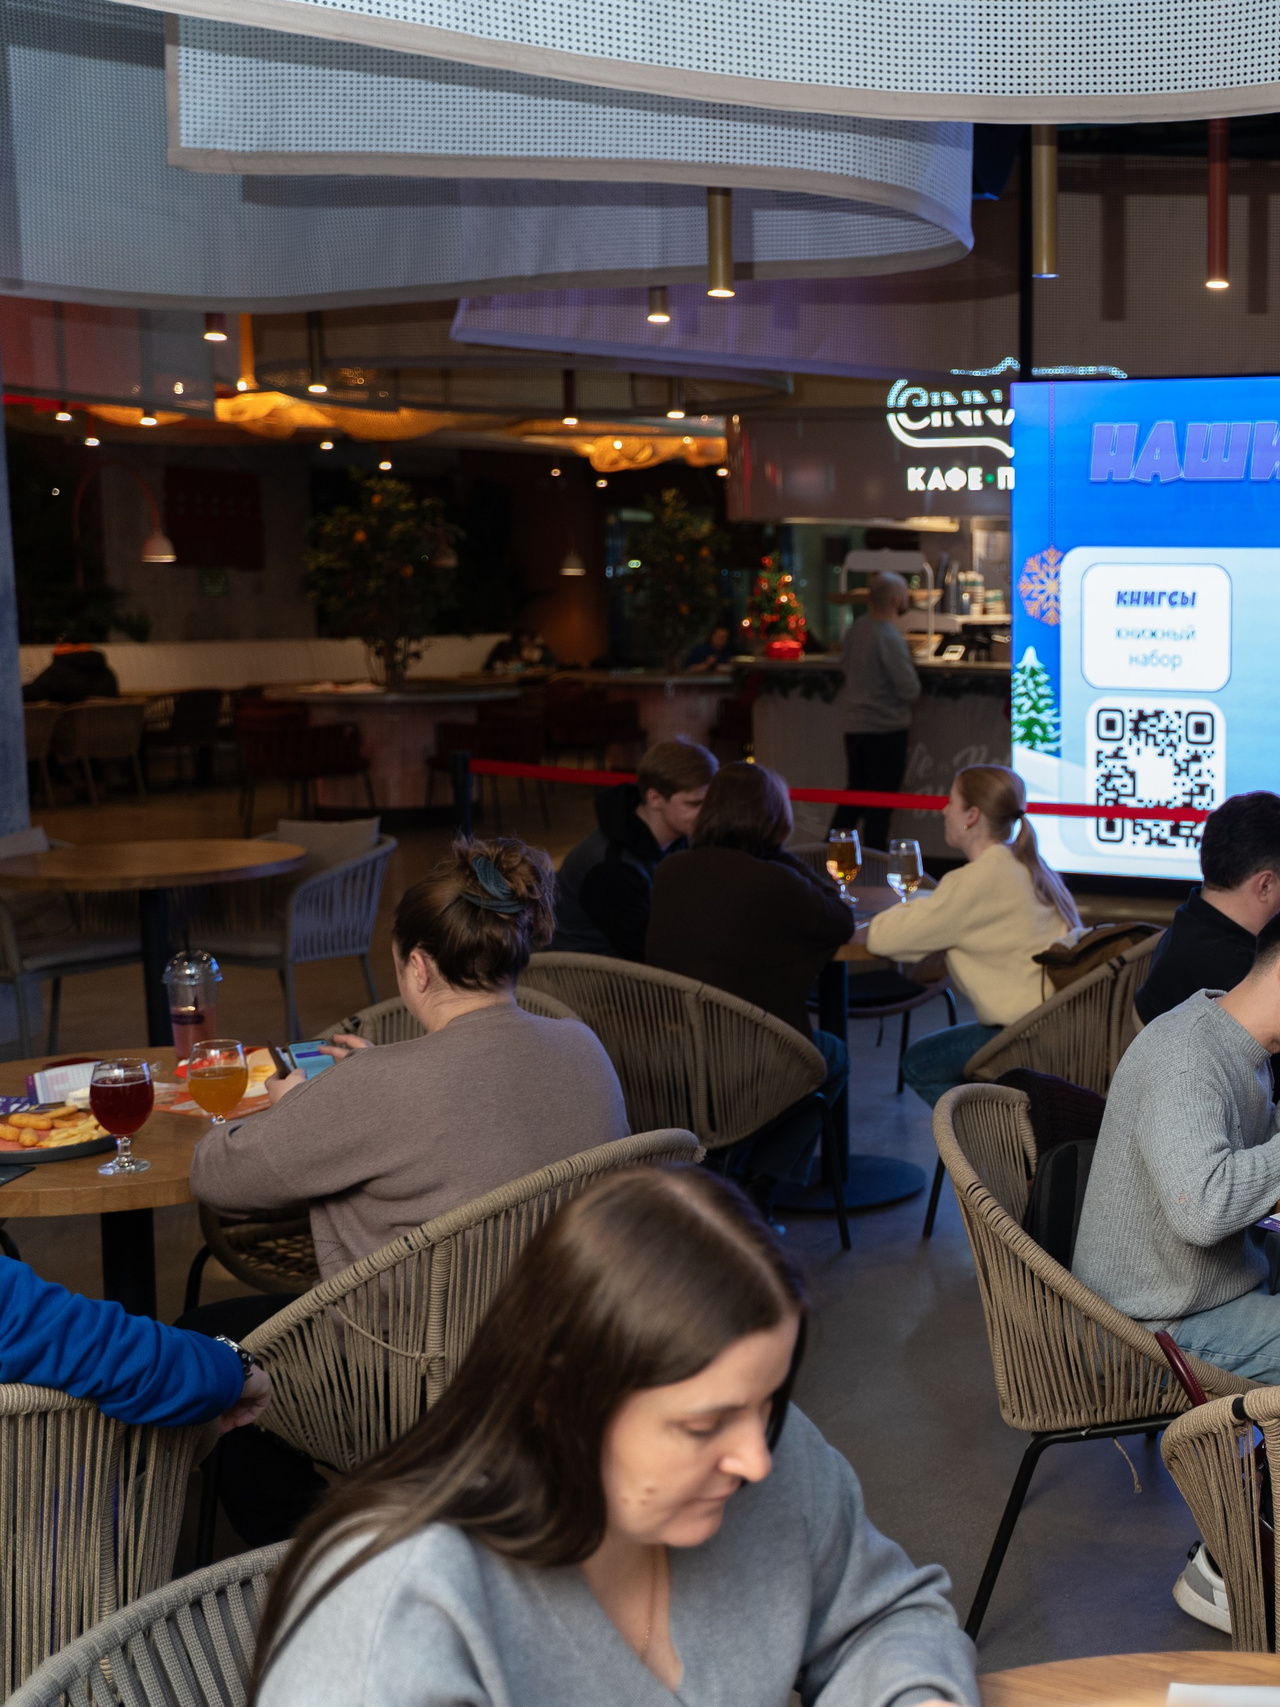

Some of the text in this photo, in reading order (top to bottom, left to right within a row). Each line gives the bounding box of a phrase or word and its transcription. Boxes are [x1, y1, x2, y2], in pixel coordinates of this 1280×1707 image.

[1116, 590, 1197, 607] КНИГСЫ
[1116, 624, 1197, 641] книжный
[1128, 648, 1183, 671] набор
